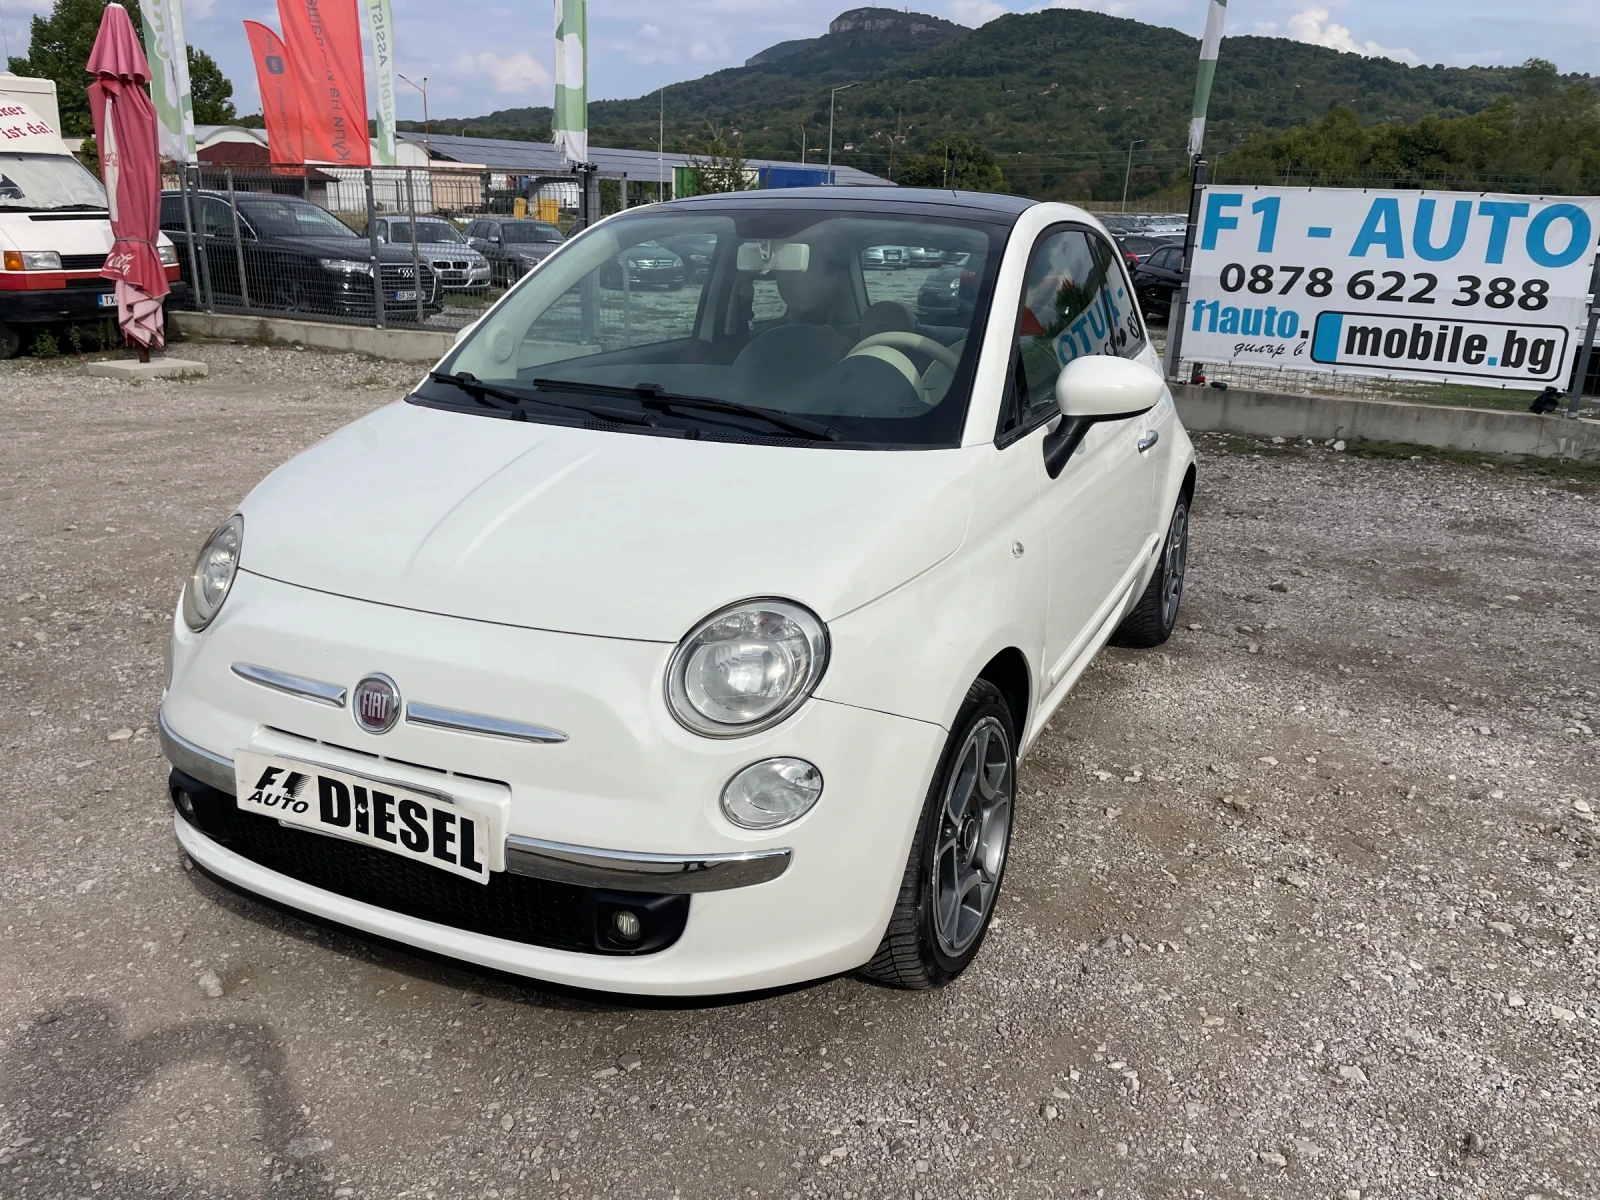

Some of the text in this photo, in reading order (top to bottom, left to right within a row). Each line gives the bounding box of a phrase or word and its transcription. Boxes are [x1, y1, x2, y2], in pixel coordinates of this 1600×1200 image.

[2, 120, 54, 140] ist da!
[1200, 193, 1281, 254] F1
[1348, 197, 1592, 269] AUTO
[1219, 262, 1551, 311] 0878 622 388
[1232, 341, 1286, 359] дилър
[1344, 323, 1557, 375] mobile.bg
[361, 690, 391, 719] FIAT
[247, 789, 310, 814] AUTO
[317, 775, 483, 875] DIESEL
